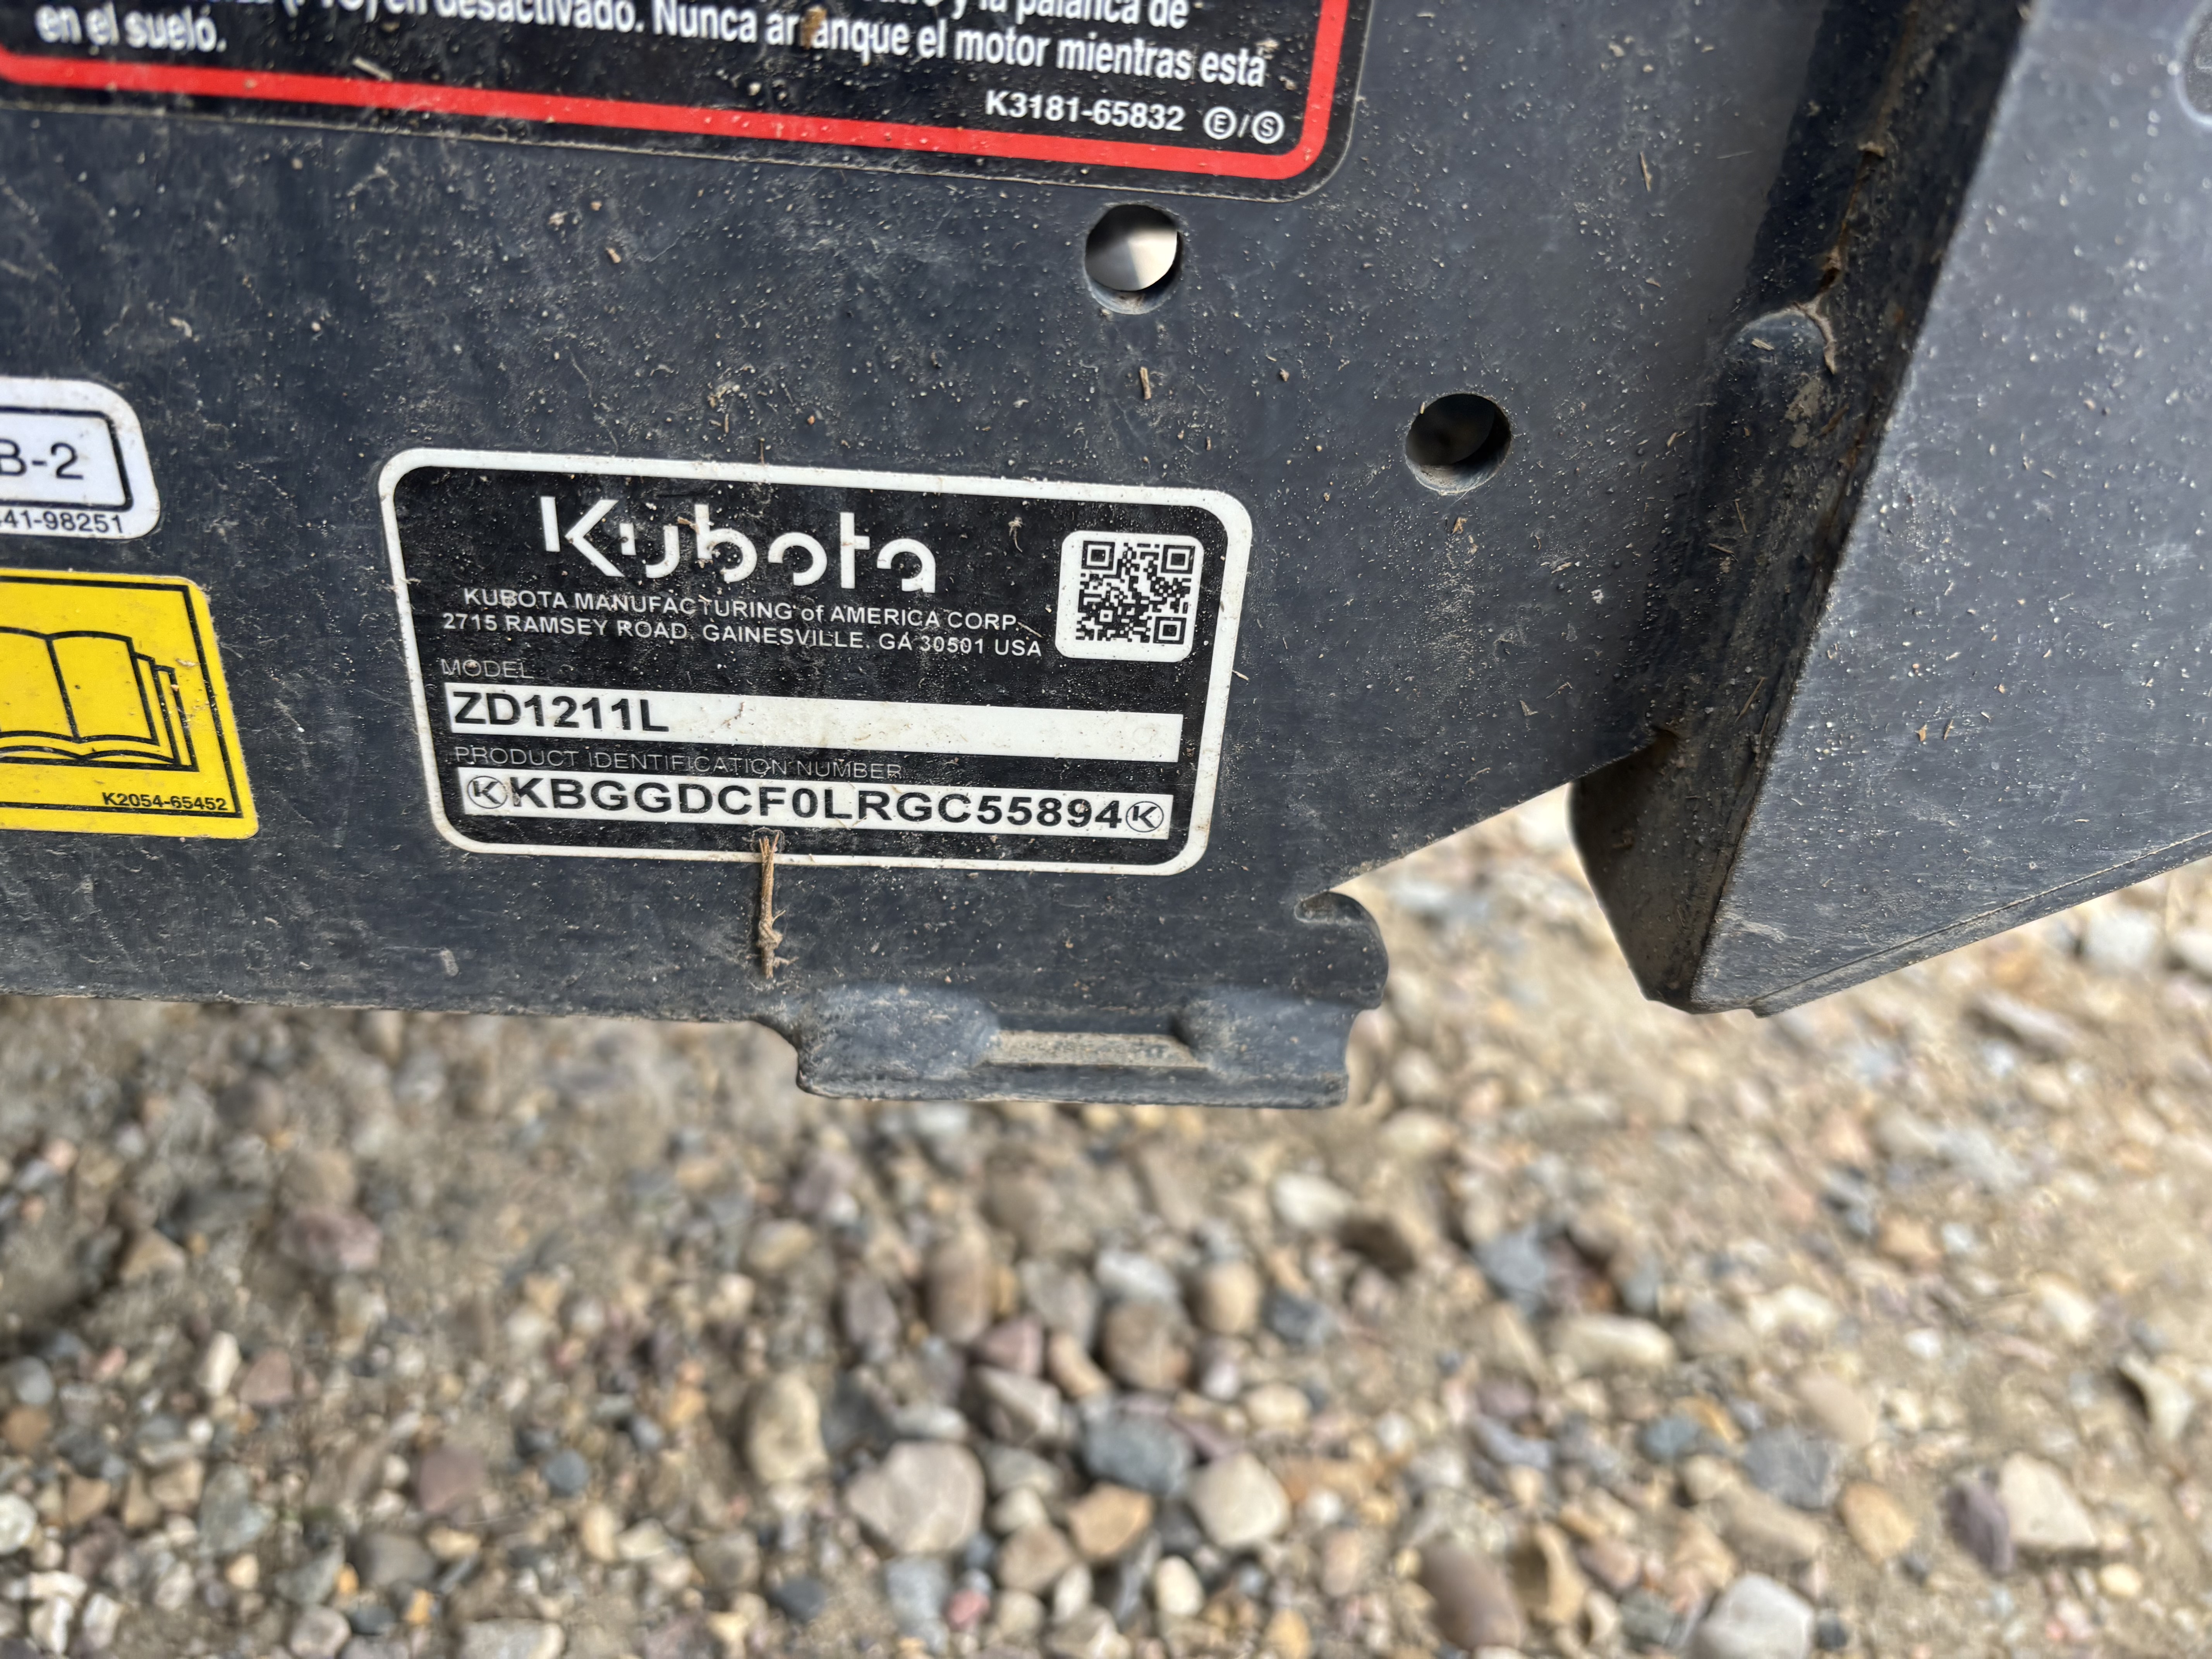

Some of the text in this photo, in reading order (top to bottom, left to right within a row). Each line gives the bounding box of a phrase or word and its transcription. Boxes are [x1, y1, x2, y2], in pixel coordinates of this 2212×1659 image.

[36, 5, 82, 44] en
[85, 2, 119, 46] el
[652, 0, 757, 43] Nunca
[917, 18, 947, 58] el
[954, 26, 1050, 67] motor
[1056, 33, 1192, 80] mientras
[985, 90, 1186, 132] K3181-65832
[0, 439, 83, 480] B-2
[0, 509, 122, 534] 41-98251
[541, 496, 936, 593] Kubota
[465, 588, 568, 609] KUBOTA
[574, 593, 793, 620] MANUFACTURING
[800, 608, 823, 622] of
[830, 606, 940, 627] AMERICA
[442, 612, 498, 631] 2715
[506, 615, 608, 636] RAMSEY
[878, 634, 913, 651] GA
[920, 636, 984, 654] 30501
[994, 639, 1042, 657] USA
[440, 658, 534, 679] MODEL
[452, 691, 669, 733] ZD1211L
[455, 746, 902, 778] PRODUCT IDENTIFICATION NUMBER
[102, 792, 228, 810] K2054-65452
[509, 777, 1121, 829] KBGGDCF0LRGC55894
